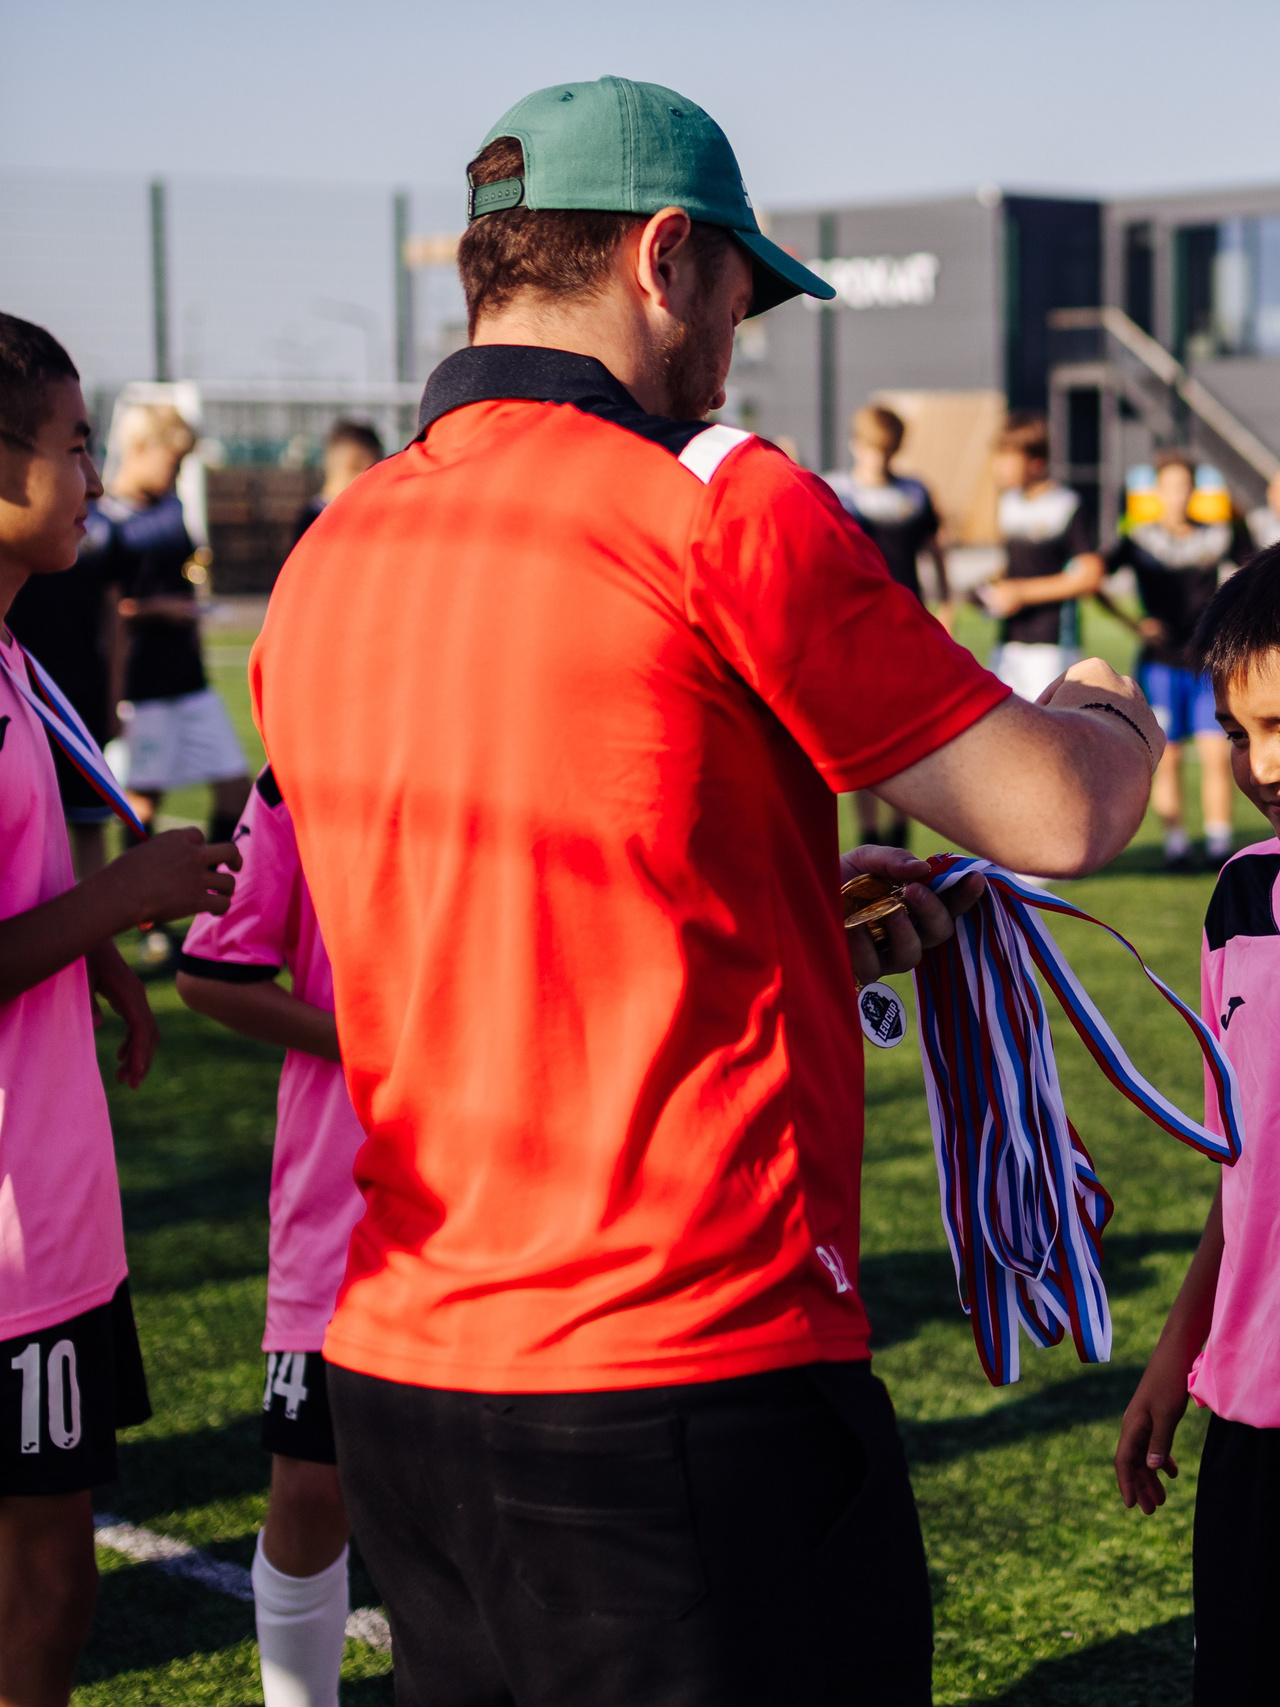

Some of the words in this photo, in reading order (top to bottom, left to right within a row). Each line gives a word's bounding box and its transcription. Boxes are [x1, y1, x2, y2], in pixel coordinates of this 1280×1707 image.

[877, 1020, 891, 1039] LEO
[885, 1002, 899, 1023] CUP
[11, 1339, 81, 1454] 10
[263, 1351, 308, 1420] 14
